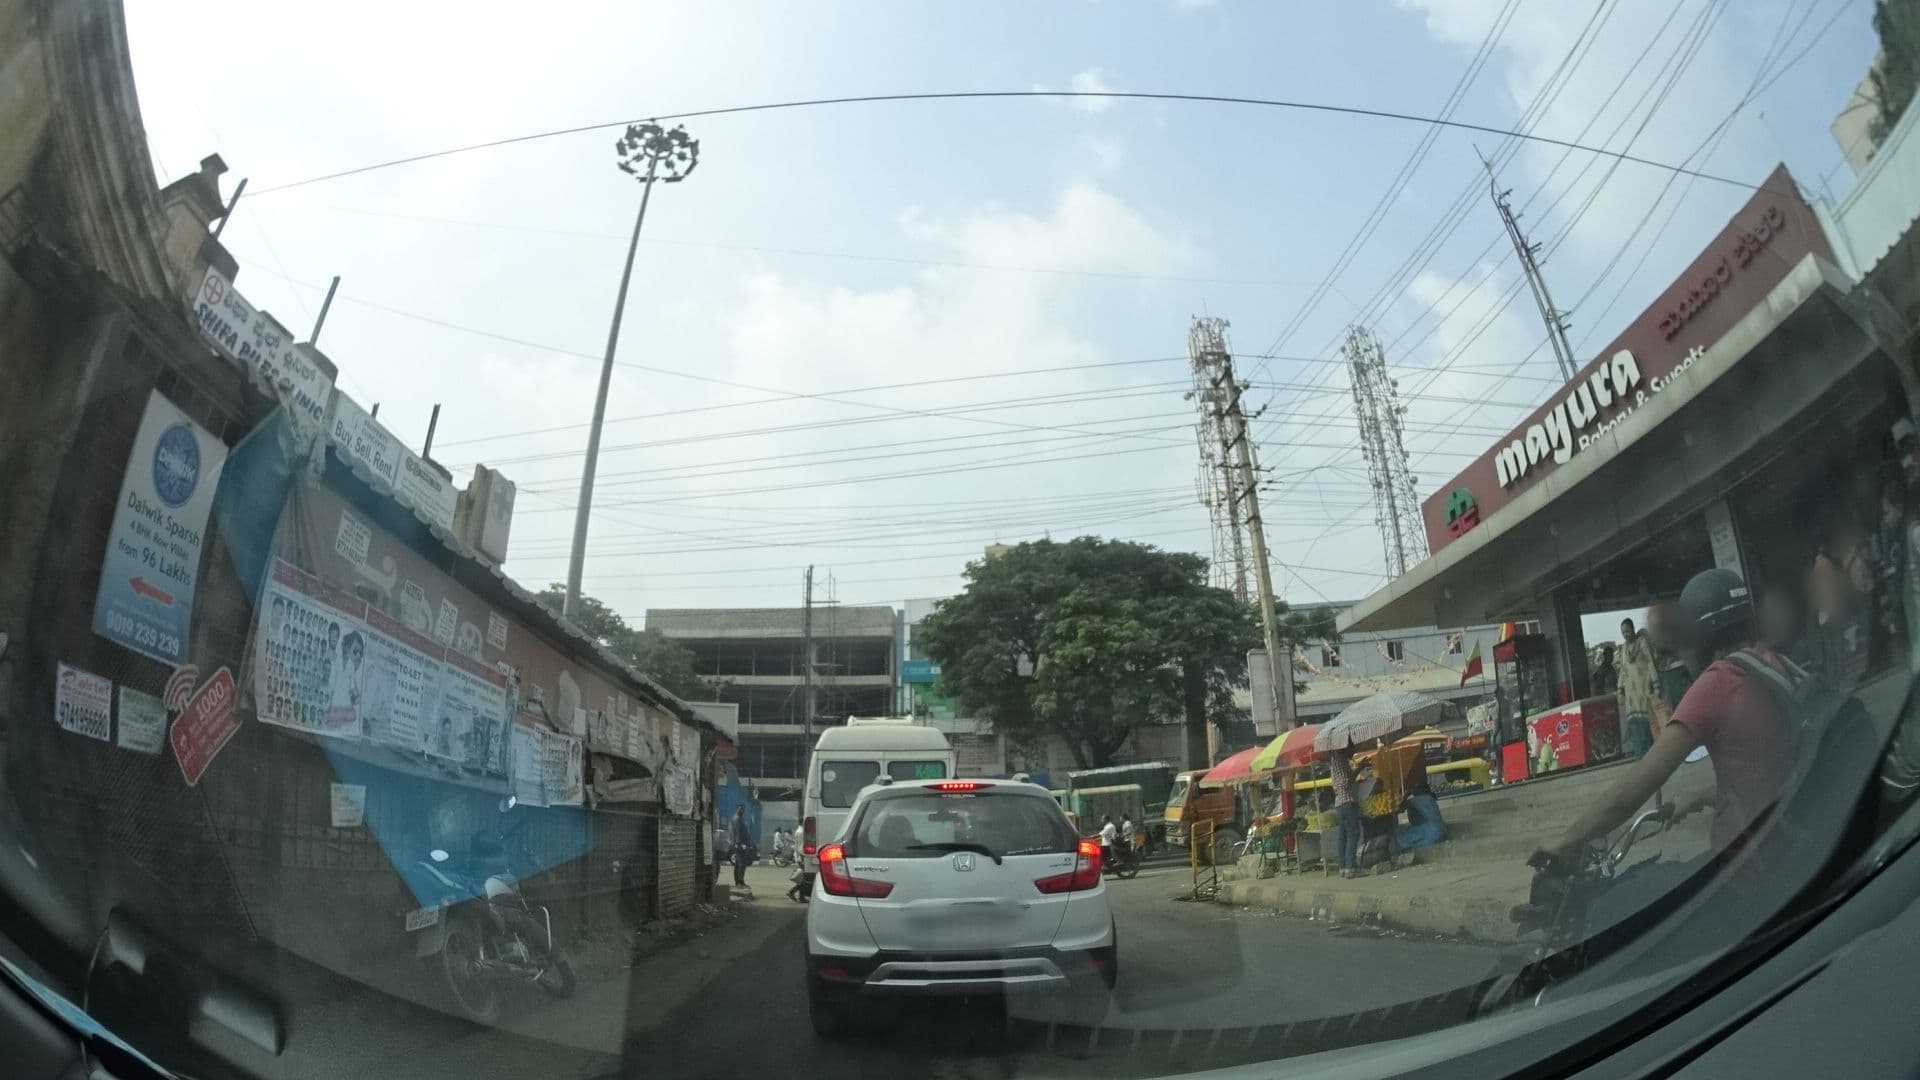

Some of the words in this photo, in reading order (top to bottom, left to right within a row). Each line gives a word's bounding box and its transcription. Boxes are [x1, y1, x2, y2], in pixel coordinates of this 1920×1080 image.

[198, 303, 239, 350] SHIFA
[335, 420, 352, 445] Buy.
[355, 436, 371, 462] Sell.
[1495, 349, 1641, 489] mayura
[1578, 407, 1632, 452] Bake
[1636, 390, 1651, 409] &
[128, 491, 164, 527] Daiwik
[166, 515, 200, 547] Sparsh
[118, 537, 138, 556] from
[142, 547, 157, 569] 96
[160, 558, 191, 586] Lakhs
[135, 622, 157, 647] 239
[159, 632, 180, 656] 239
[196, 682, 226, 717] 1000
